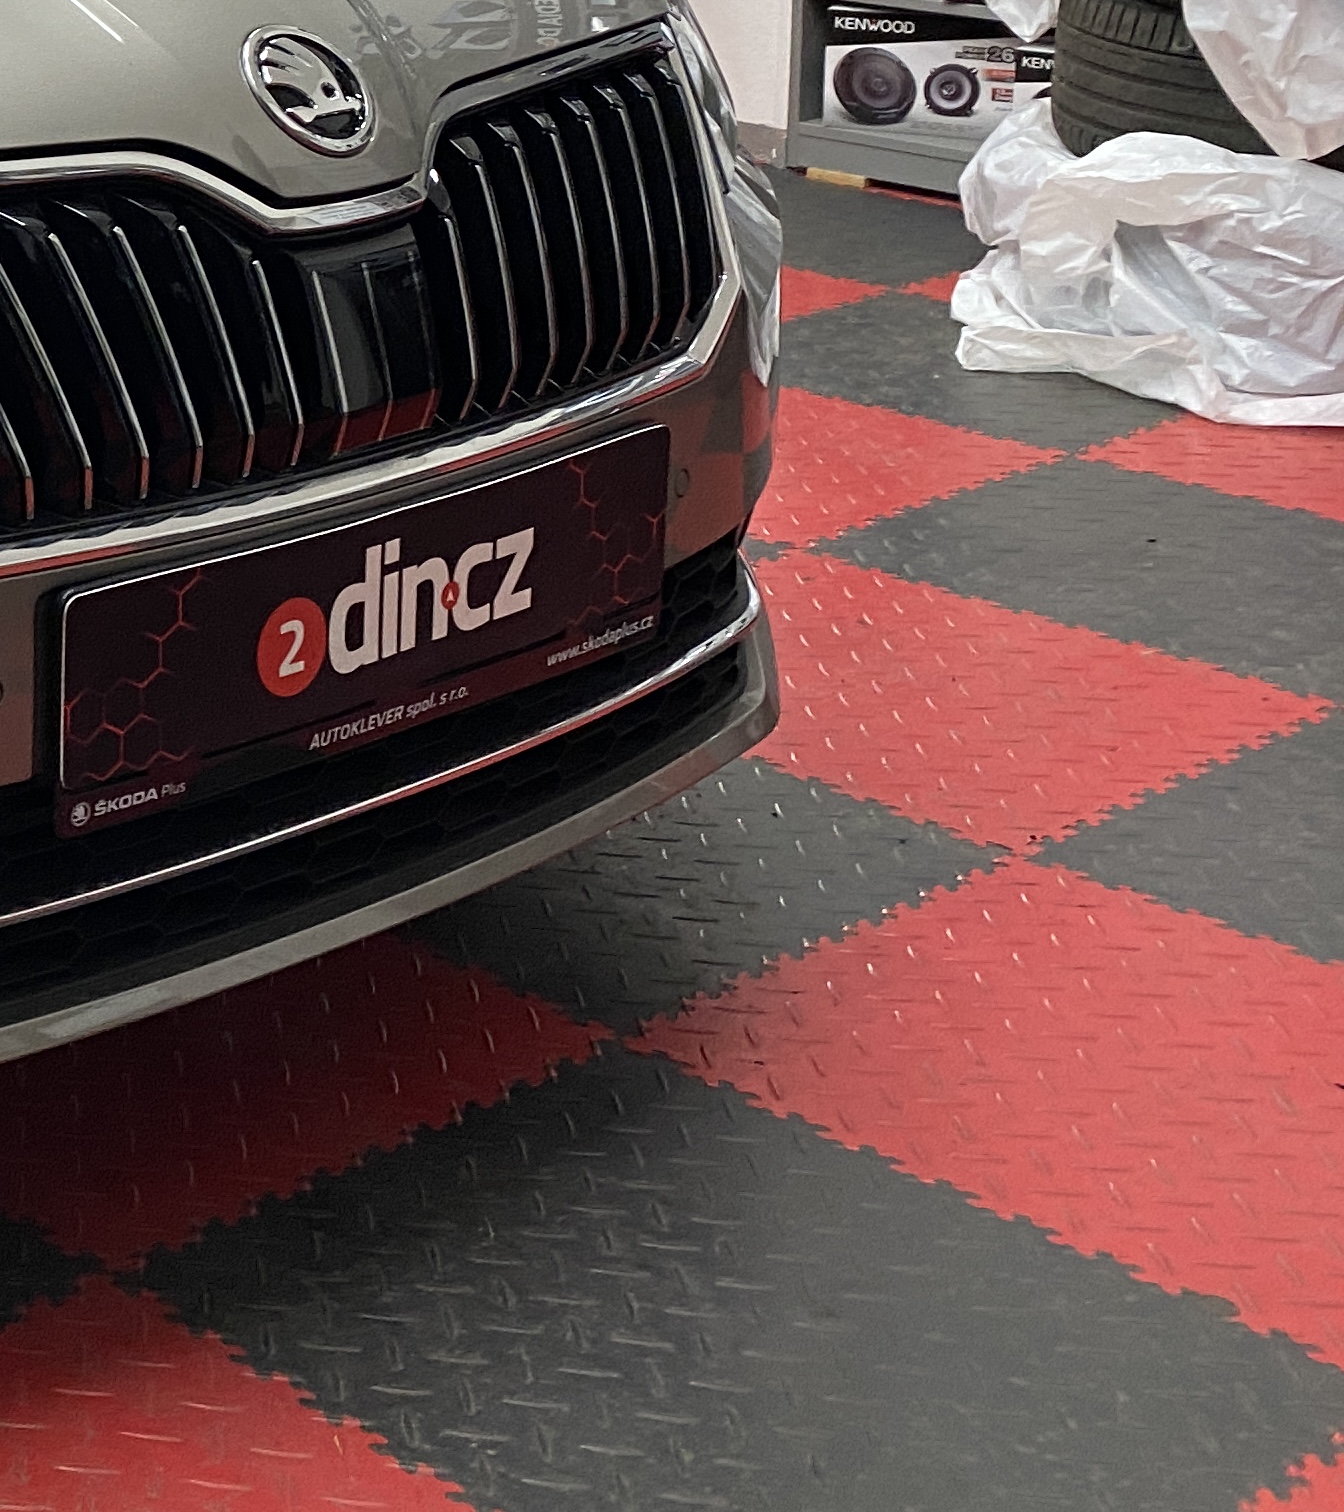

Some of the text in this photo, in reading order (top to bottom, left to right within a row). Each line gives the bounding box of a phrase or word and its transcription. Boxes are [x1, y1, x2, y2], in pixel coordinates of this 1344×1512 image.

[833, 16, 916, 34] KENWOOD
[1021, 55, 1055, 70] KEN
[308, 705, 405, 751] AUTOKLEVER
[405, 691, 437, 719] spol.
[93, 787, 159, 817] ŠKODA
